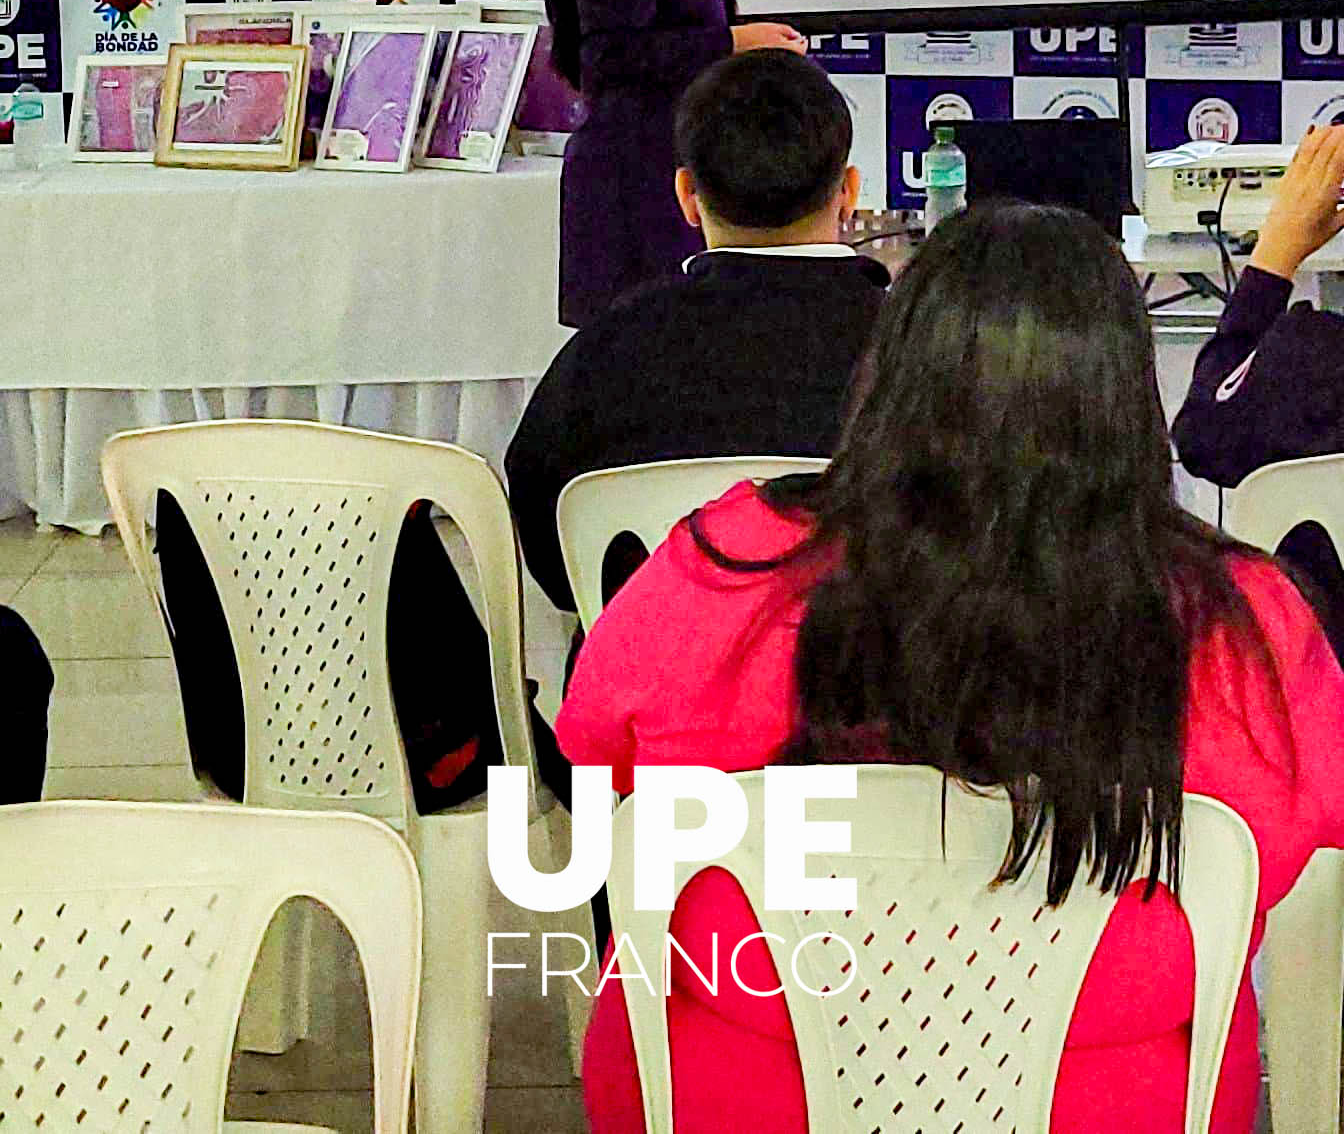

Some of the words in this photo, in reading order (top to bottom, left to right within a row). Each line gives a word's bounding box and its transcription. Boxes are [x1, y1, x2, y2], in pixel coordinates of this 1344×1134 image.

[121, 33, 138, 41] DE
[142, 32, 158, 41] LA
[96, 41, 158, 52] BONDAD
